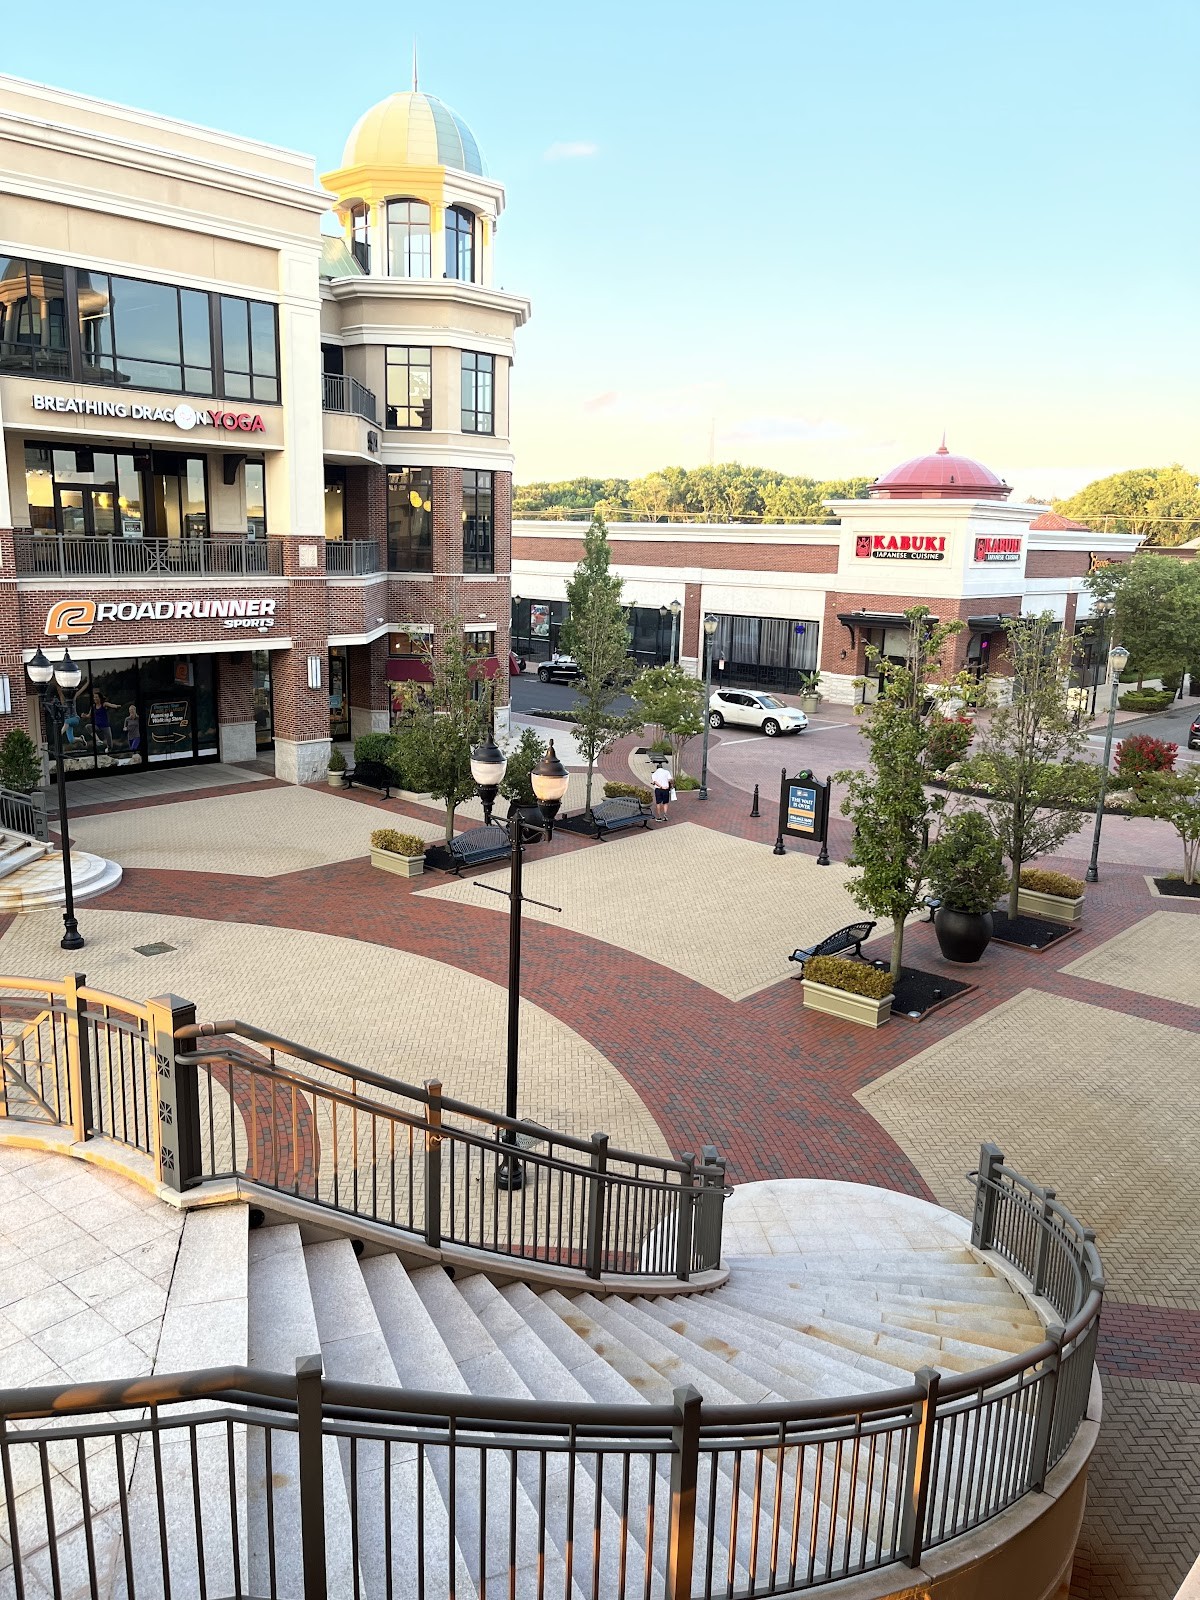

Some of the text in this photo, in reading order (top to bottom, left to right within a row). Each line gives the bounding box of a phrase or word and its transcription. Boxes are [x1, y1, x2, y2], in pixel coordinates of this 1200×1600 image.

[32, 394, 127, 418] BREATHING
[207, 409, 266, 432] YOGA
[873, 535, 946, 551] KABUKI
[985, 538, 1021, 552] KABUKI
[876, 551, 939, 560] JAPANESE CUISINE
[223, 618, 275, 629] SPORTS
